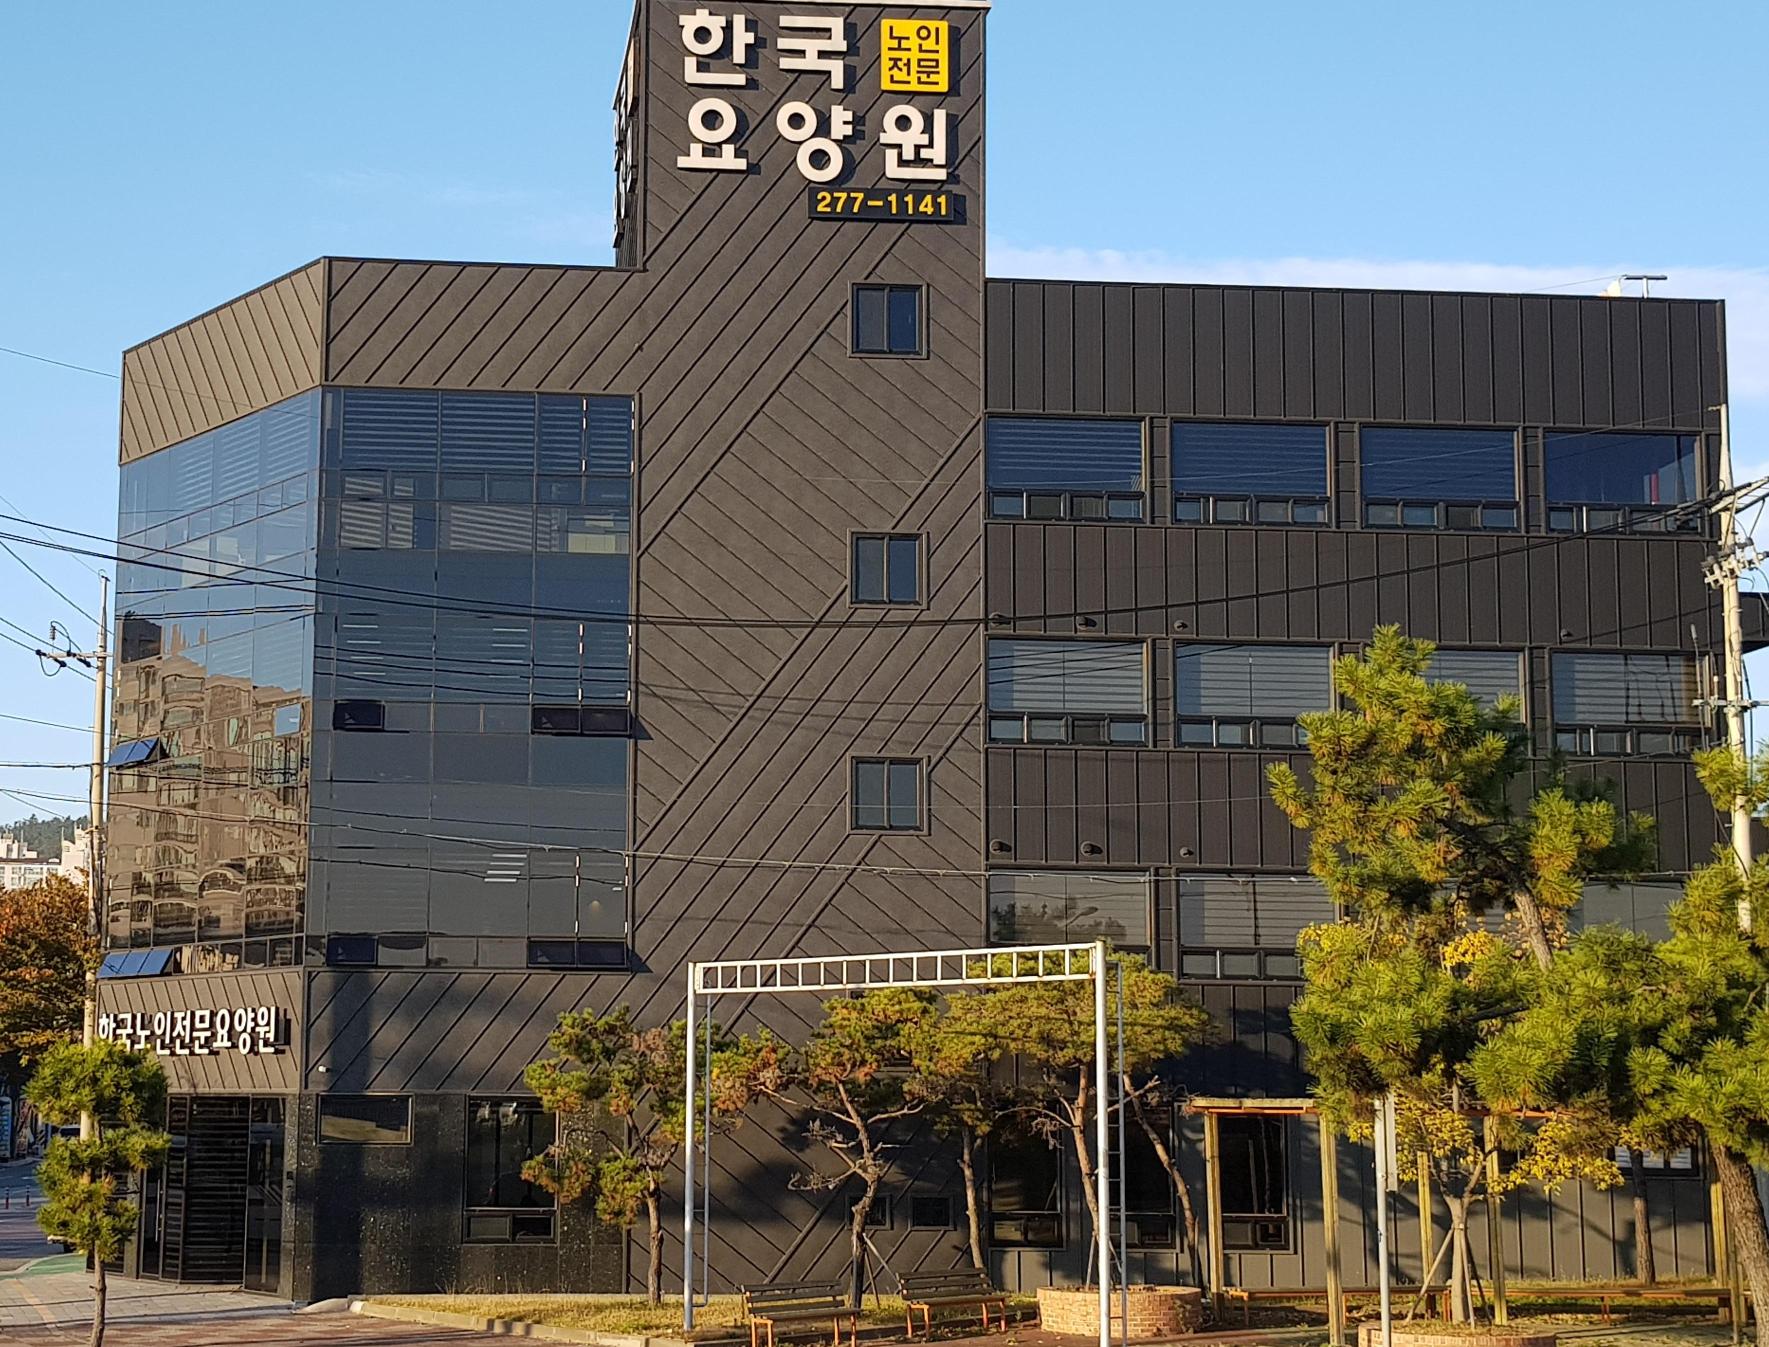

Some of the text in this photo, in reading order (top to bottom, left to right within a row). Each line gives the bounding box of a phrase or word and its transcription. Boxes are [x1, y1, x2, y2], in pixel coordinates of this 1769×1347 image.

[678, 9, 848, 90] 한국
[887, 25, 941, 54] 노인
[887, 57, 941, 85] 전문
[676, 97, 948, 182] 요양원
[816, 191, 948, 216] 277-1141
